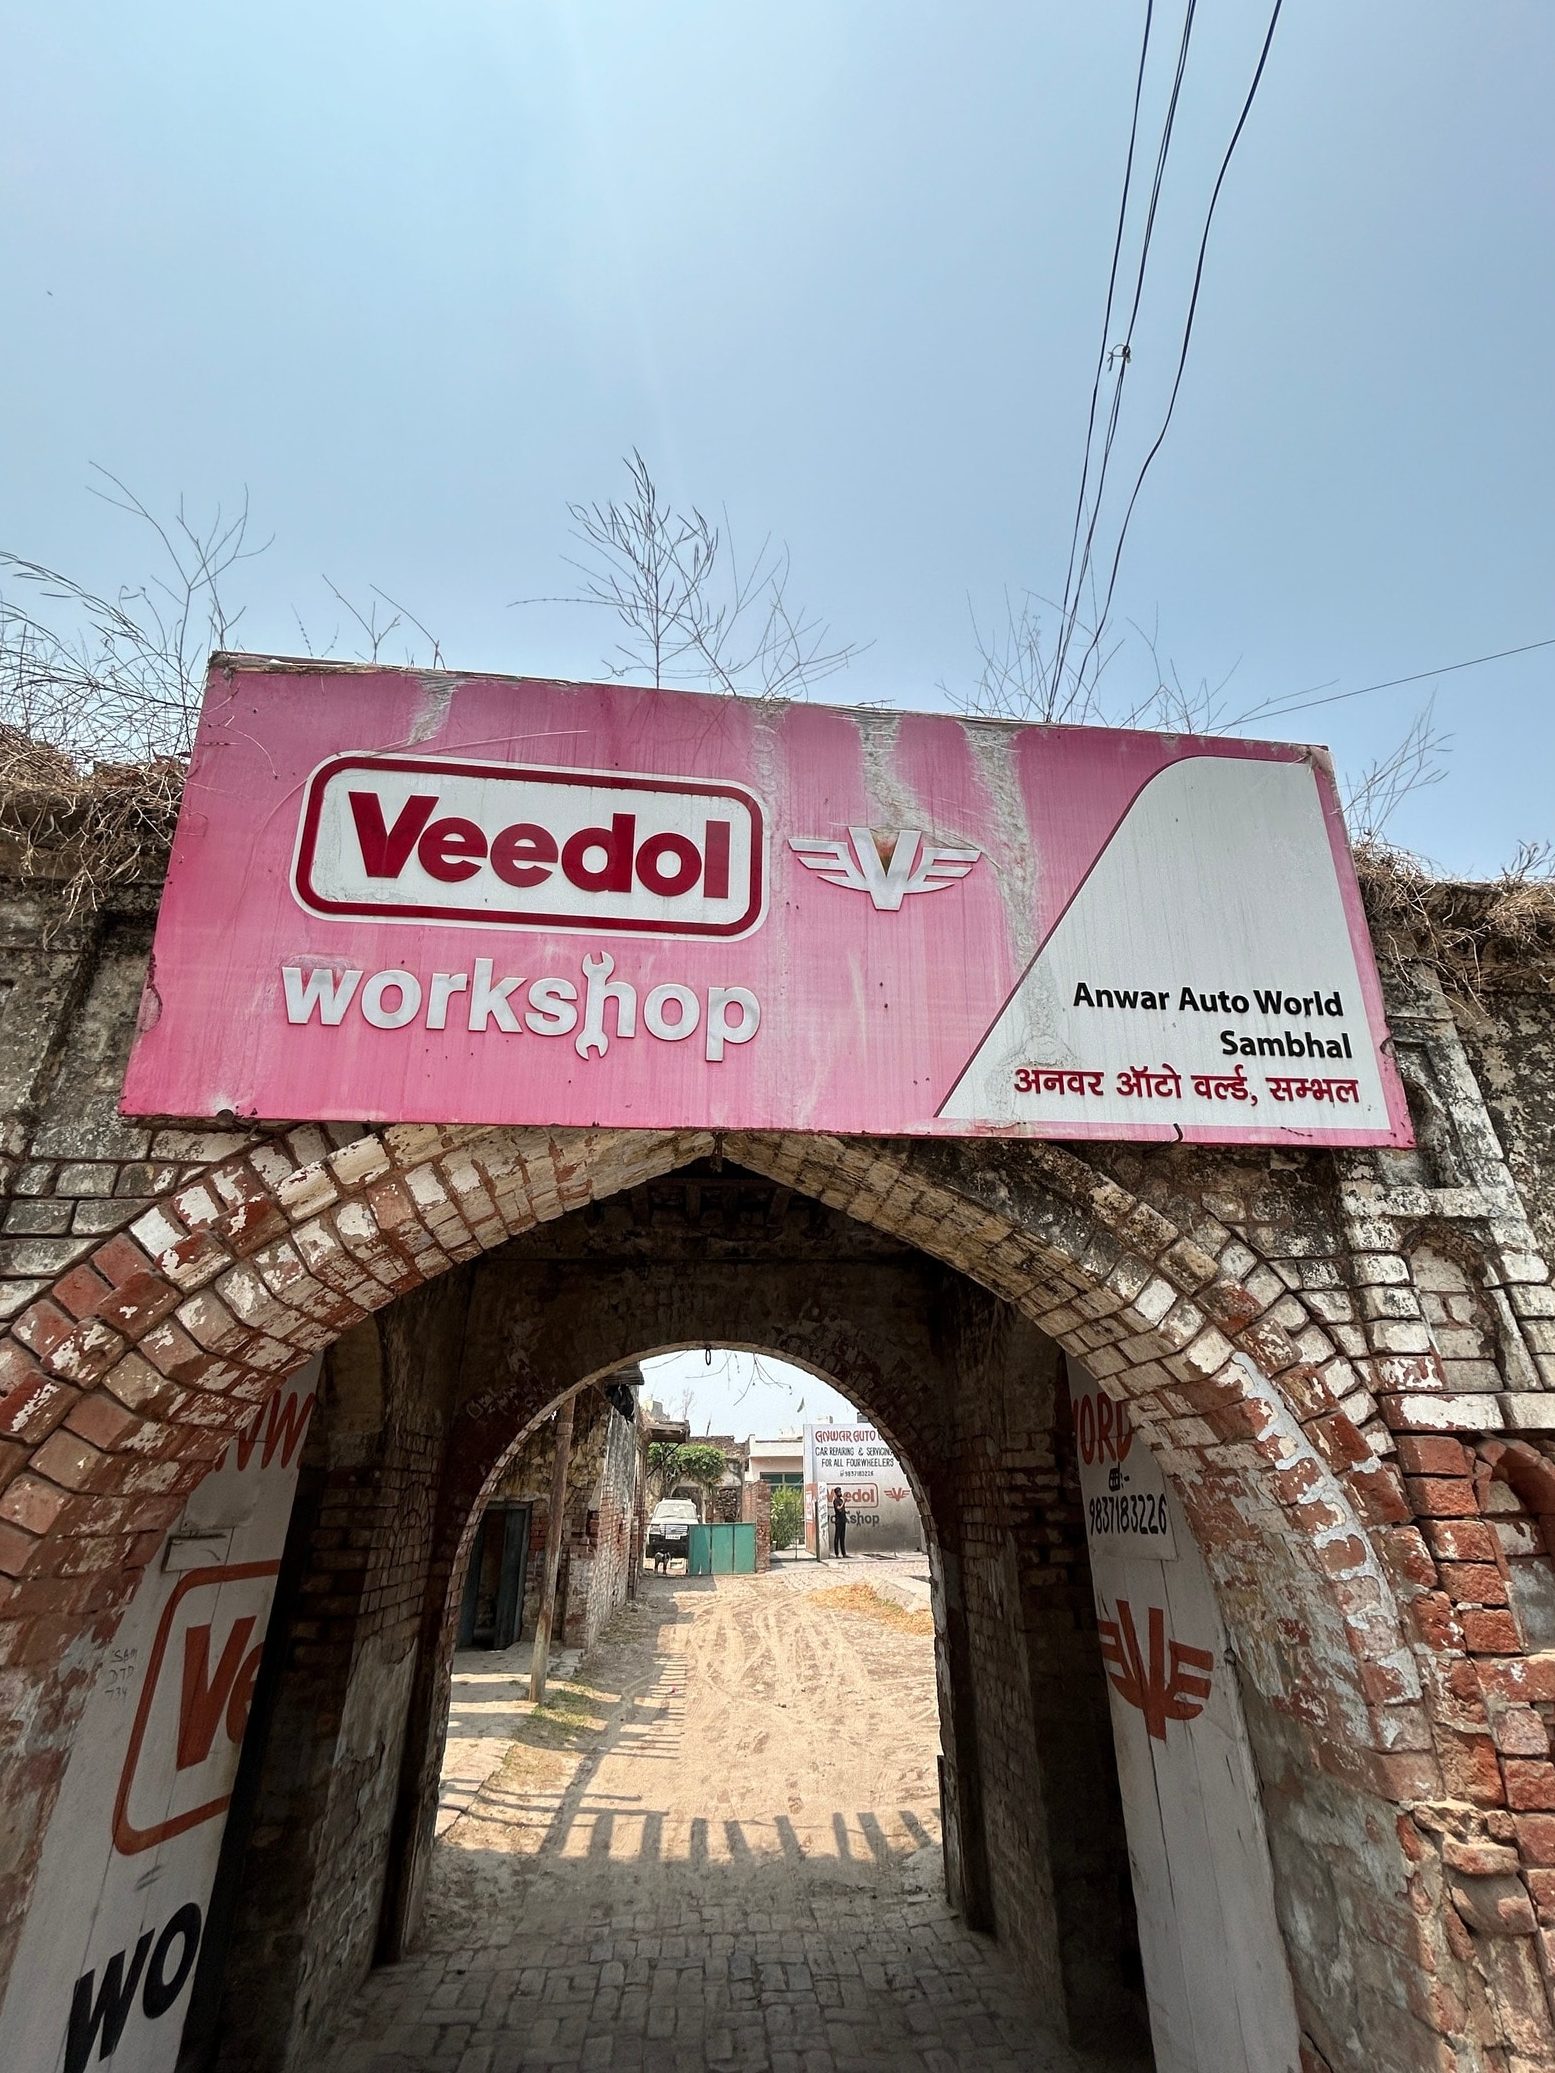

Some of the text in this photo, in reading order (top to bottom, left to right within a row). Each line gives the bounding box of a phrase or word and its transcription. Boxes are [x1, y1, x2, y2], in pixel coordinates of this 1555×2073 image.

[347, 791, 731, 900] Veedol
[281, 951, 760, 1062] workshop
[1073, 982, 1344, 1017] Anwar Auto World
[1220, 1030, 1353, 1059] Sambhal
[1014, 1063, 1360, 1106] अनवर ऑटो वर्ल्ड, सम्भल
[815, 1430, 853, 1443] ANWAR
[853, 1430, 876, 1443] AUTO
[1073, 1392, 1133, 1465] ORD
[815, 1446, 828, 1456] CAR
[821, 1458, 833, 1467] FOR
[833, 1458, 844, 1467] ALL
[1089, 1493, 1168, 1536] 9837183226
